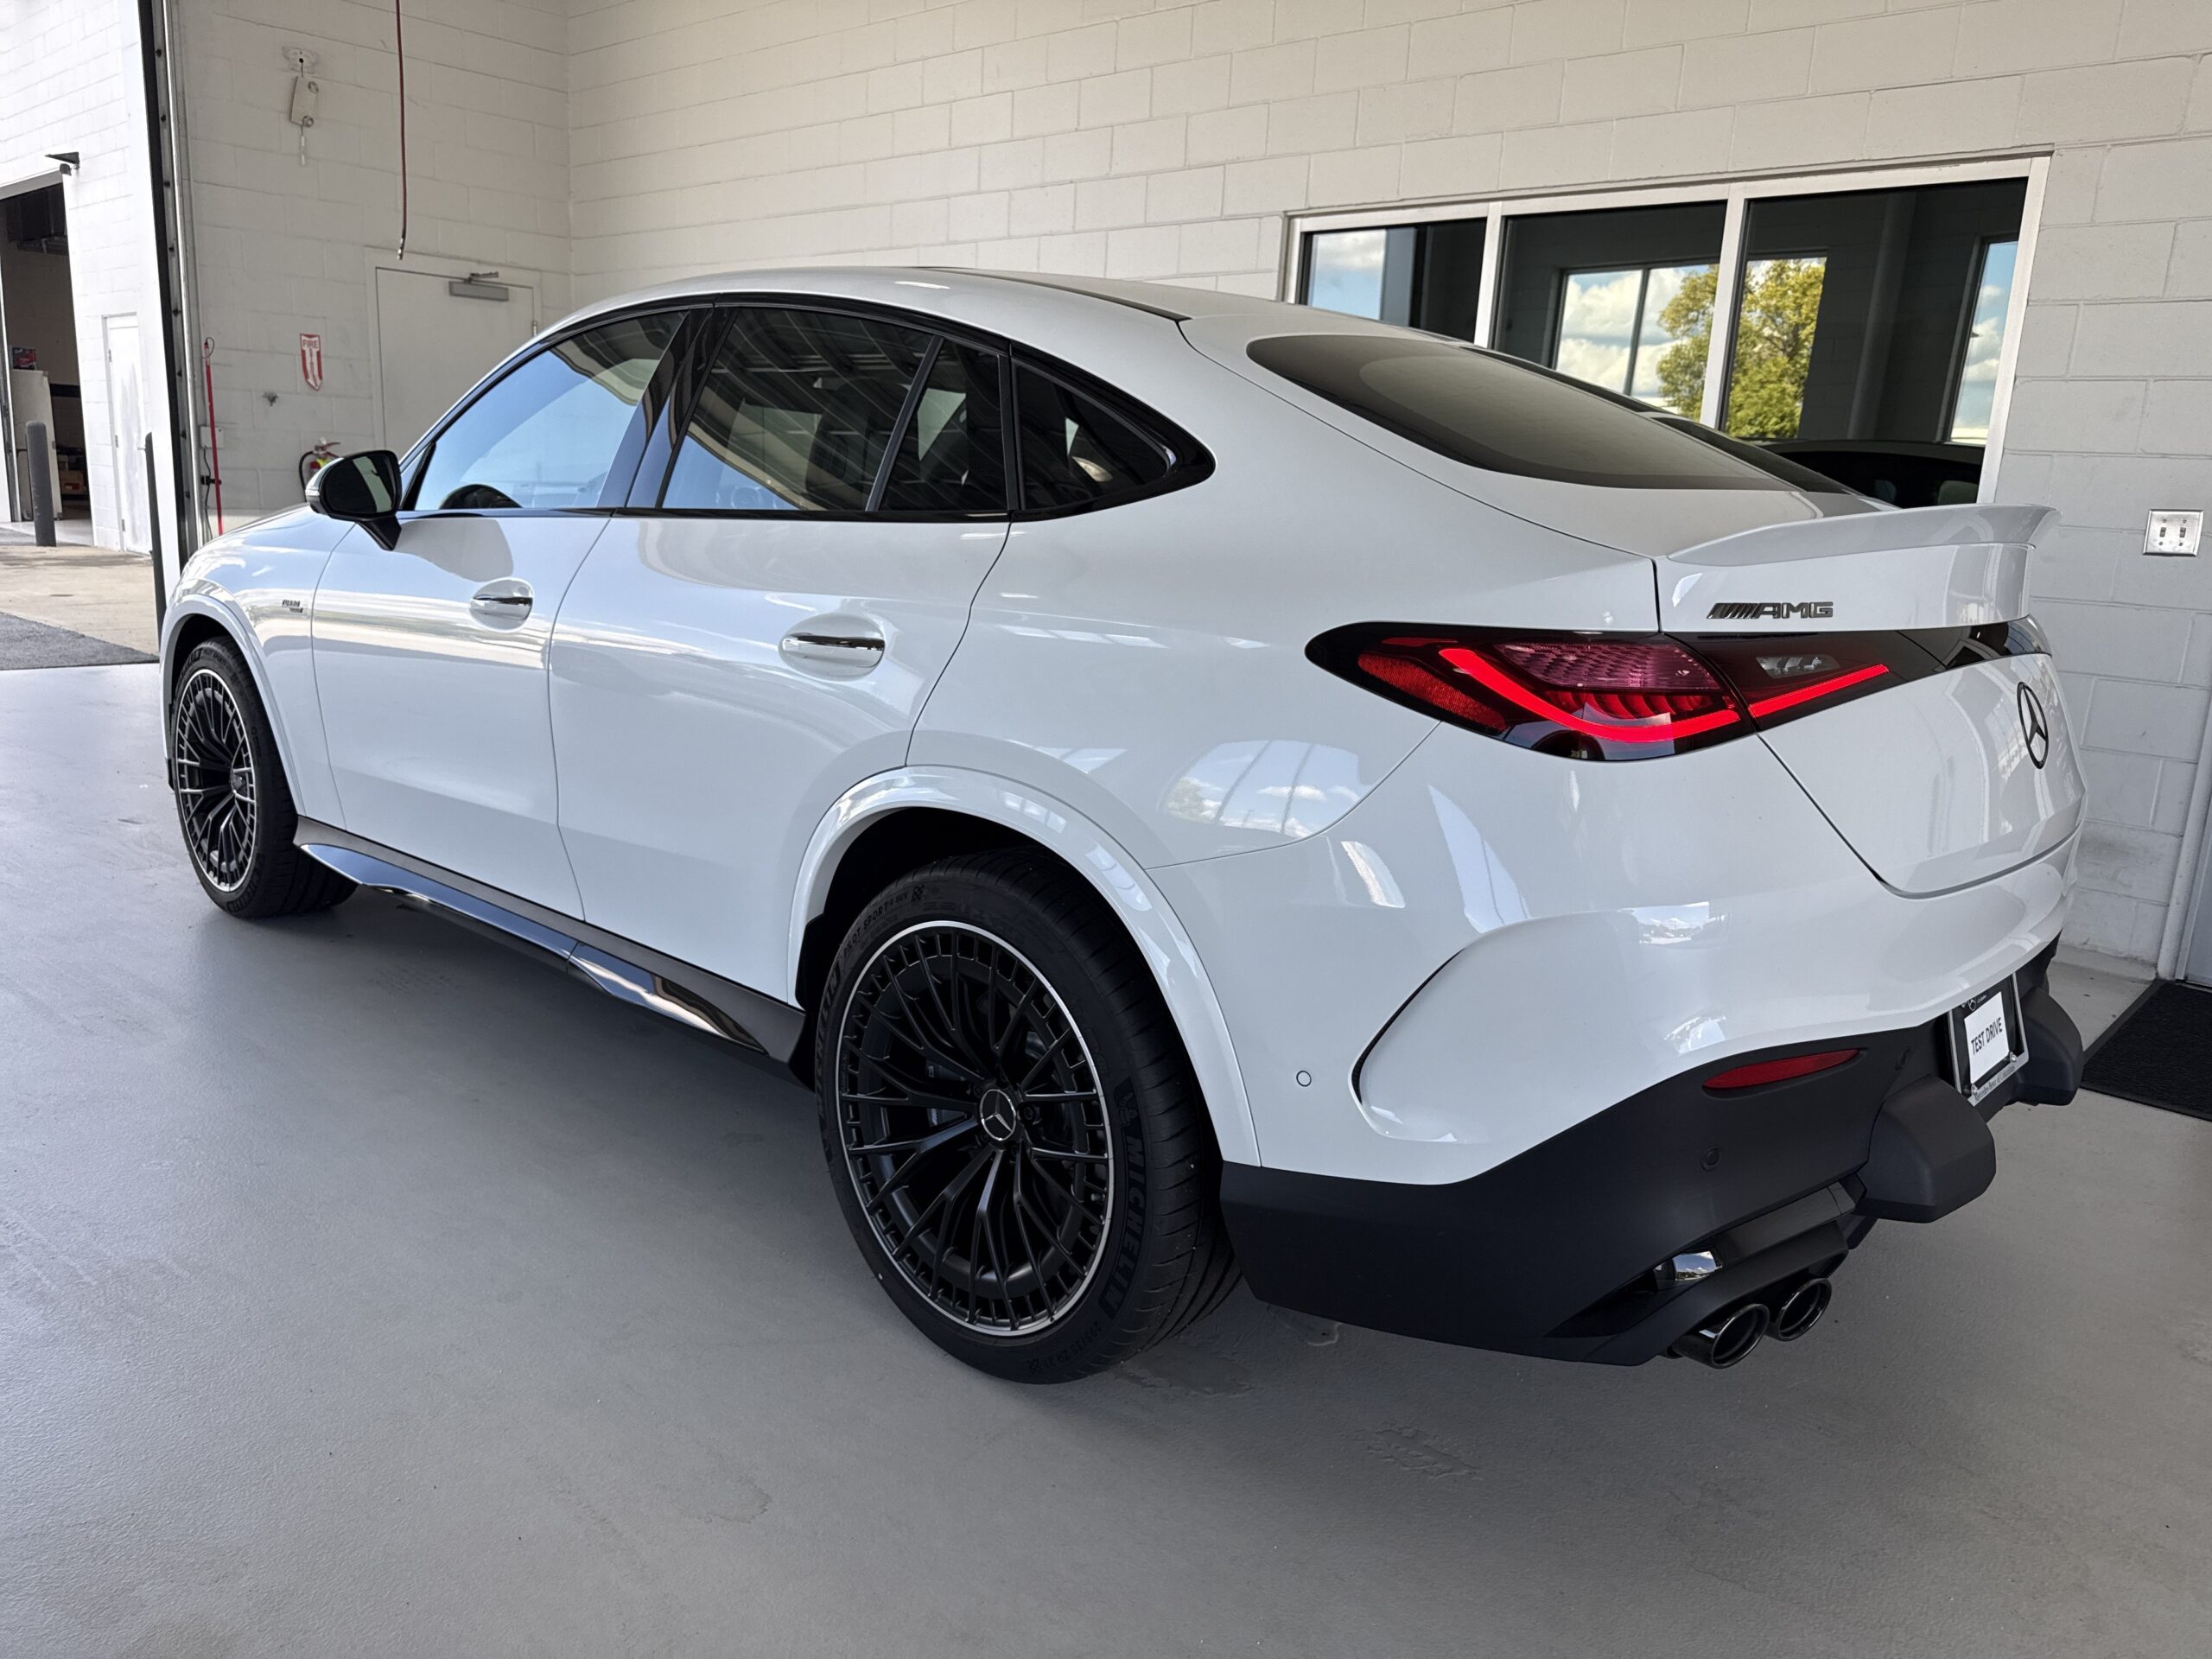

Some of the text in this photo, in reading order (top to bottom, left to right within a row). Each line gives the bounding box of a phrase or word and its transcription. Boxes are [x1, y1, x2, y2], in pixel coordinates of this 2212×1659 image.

[303, 340, 318, 348] FIRE
[1751, 602, 1834, 619] AMG
[843, 927, 861, 957] PILOT
[863, 901, 889, 930] SPORT
[1971, 1017, 2003, 1055] TEST DRIVE
[1104, 1135, 1146, 1313] MICHELIN
